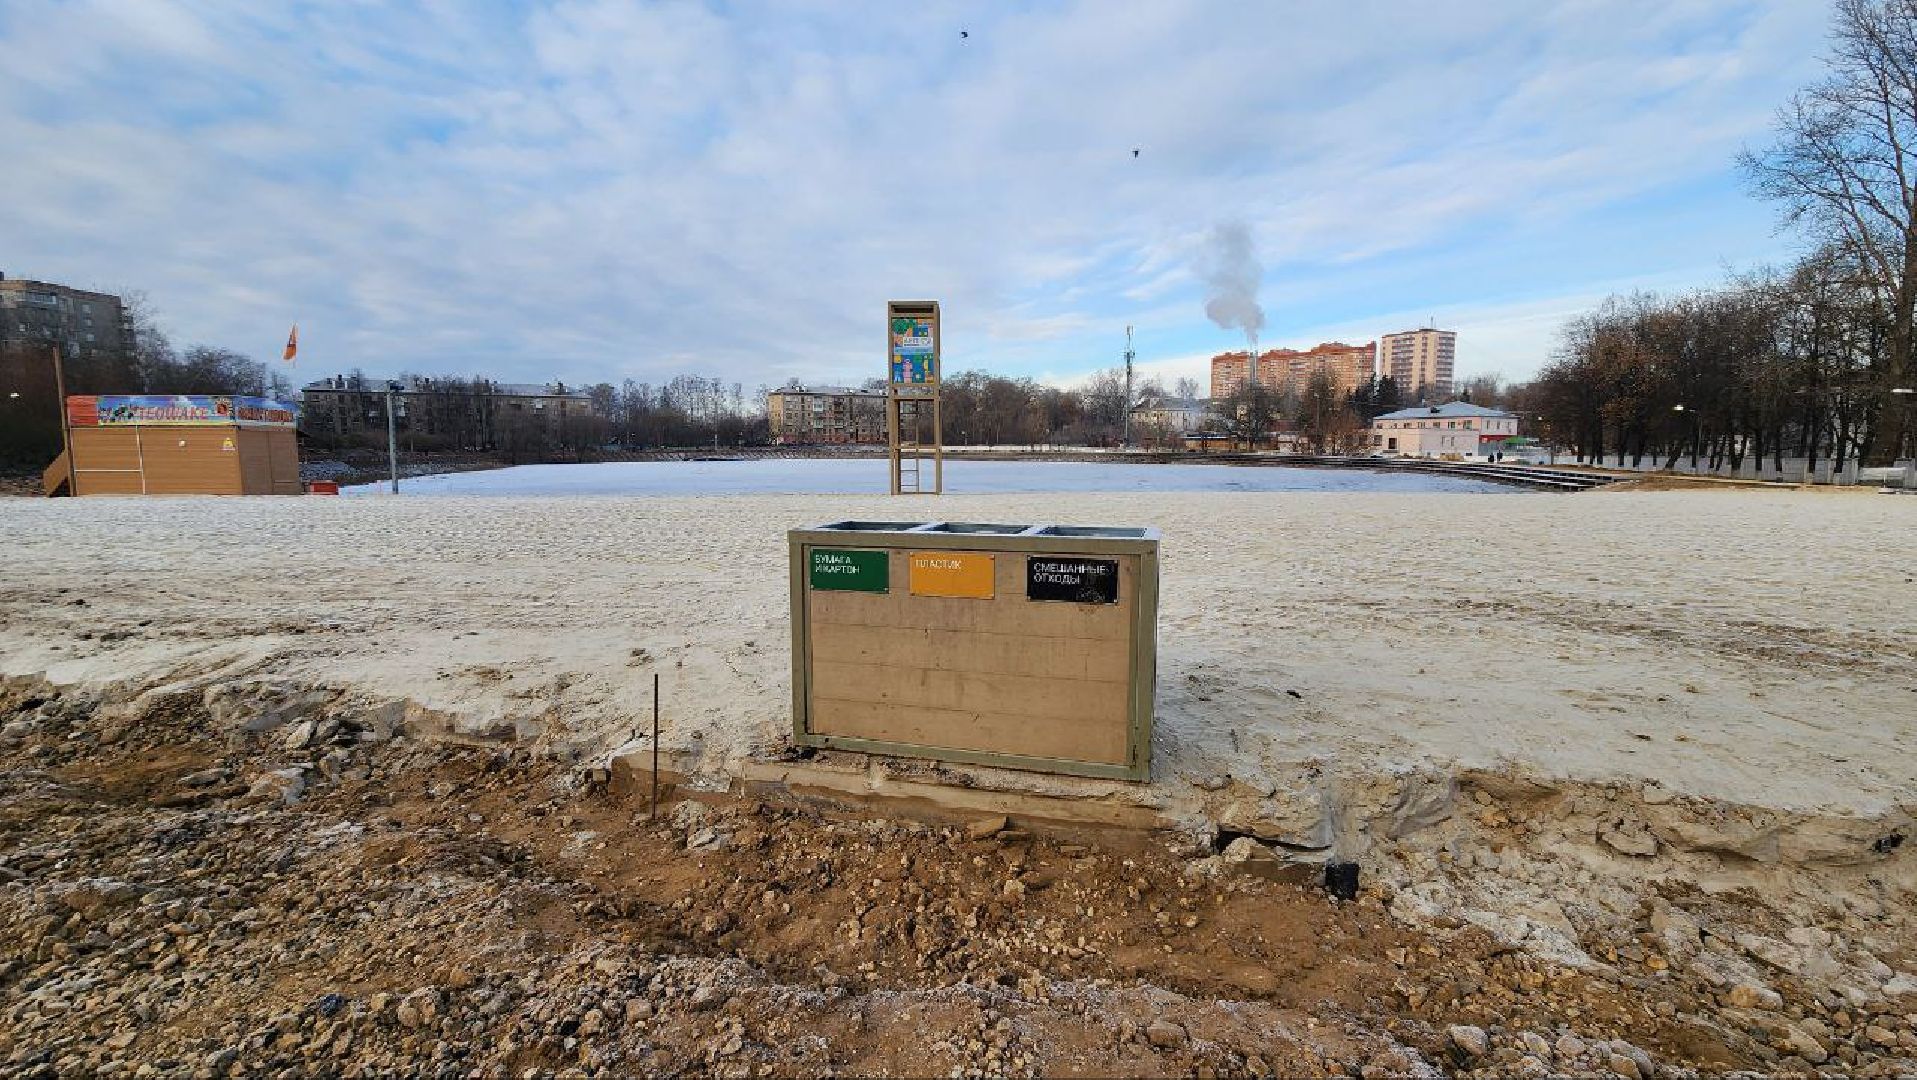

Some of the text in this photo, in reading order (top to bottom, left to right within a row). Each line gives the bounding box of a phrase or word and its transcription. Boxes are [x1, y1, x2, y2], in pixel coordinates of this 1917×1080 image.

[815, 554, 852, 564] БУМАГА
[915, 559, 961, 569] ПЛАСТИК
[1033, 572, 1080, 584] ОТХОДЫ
